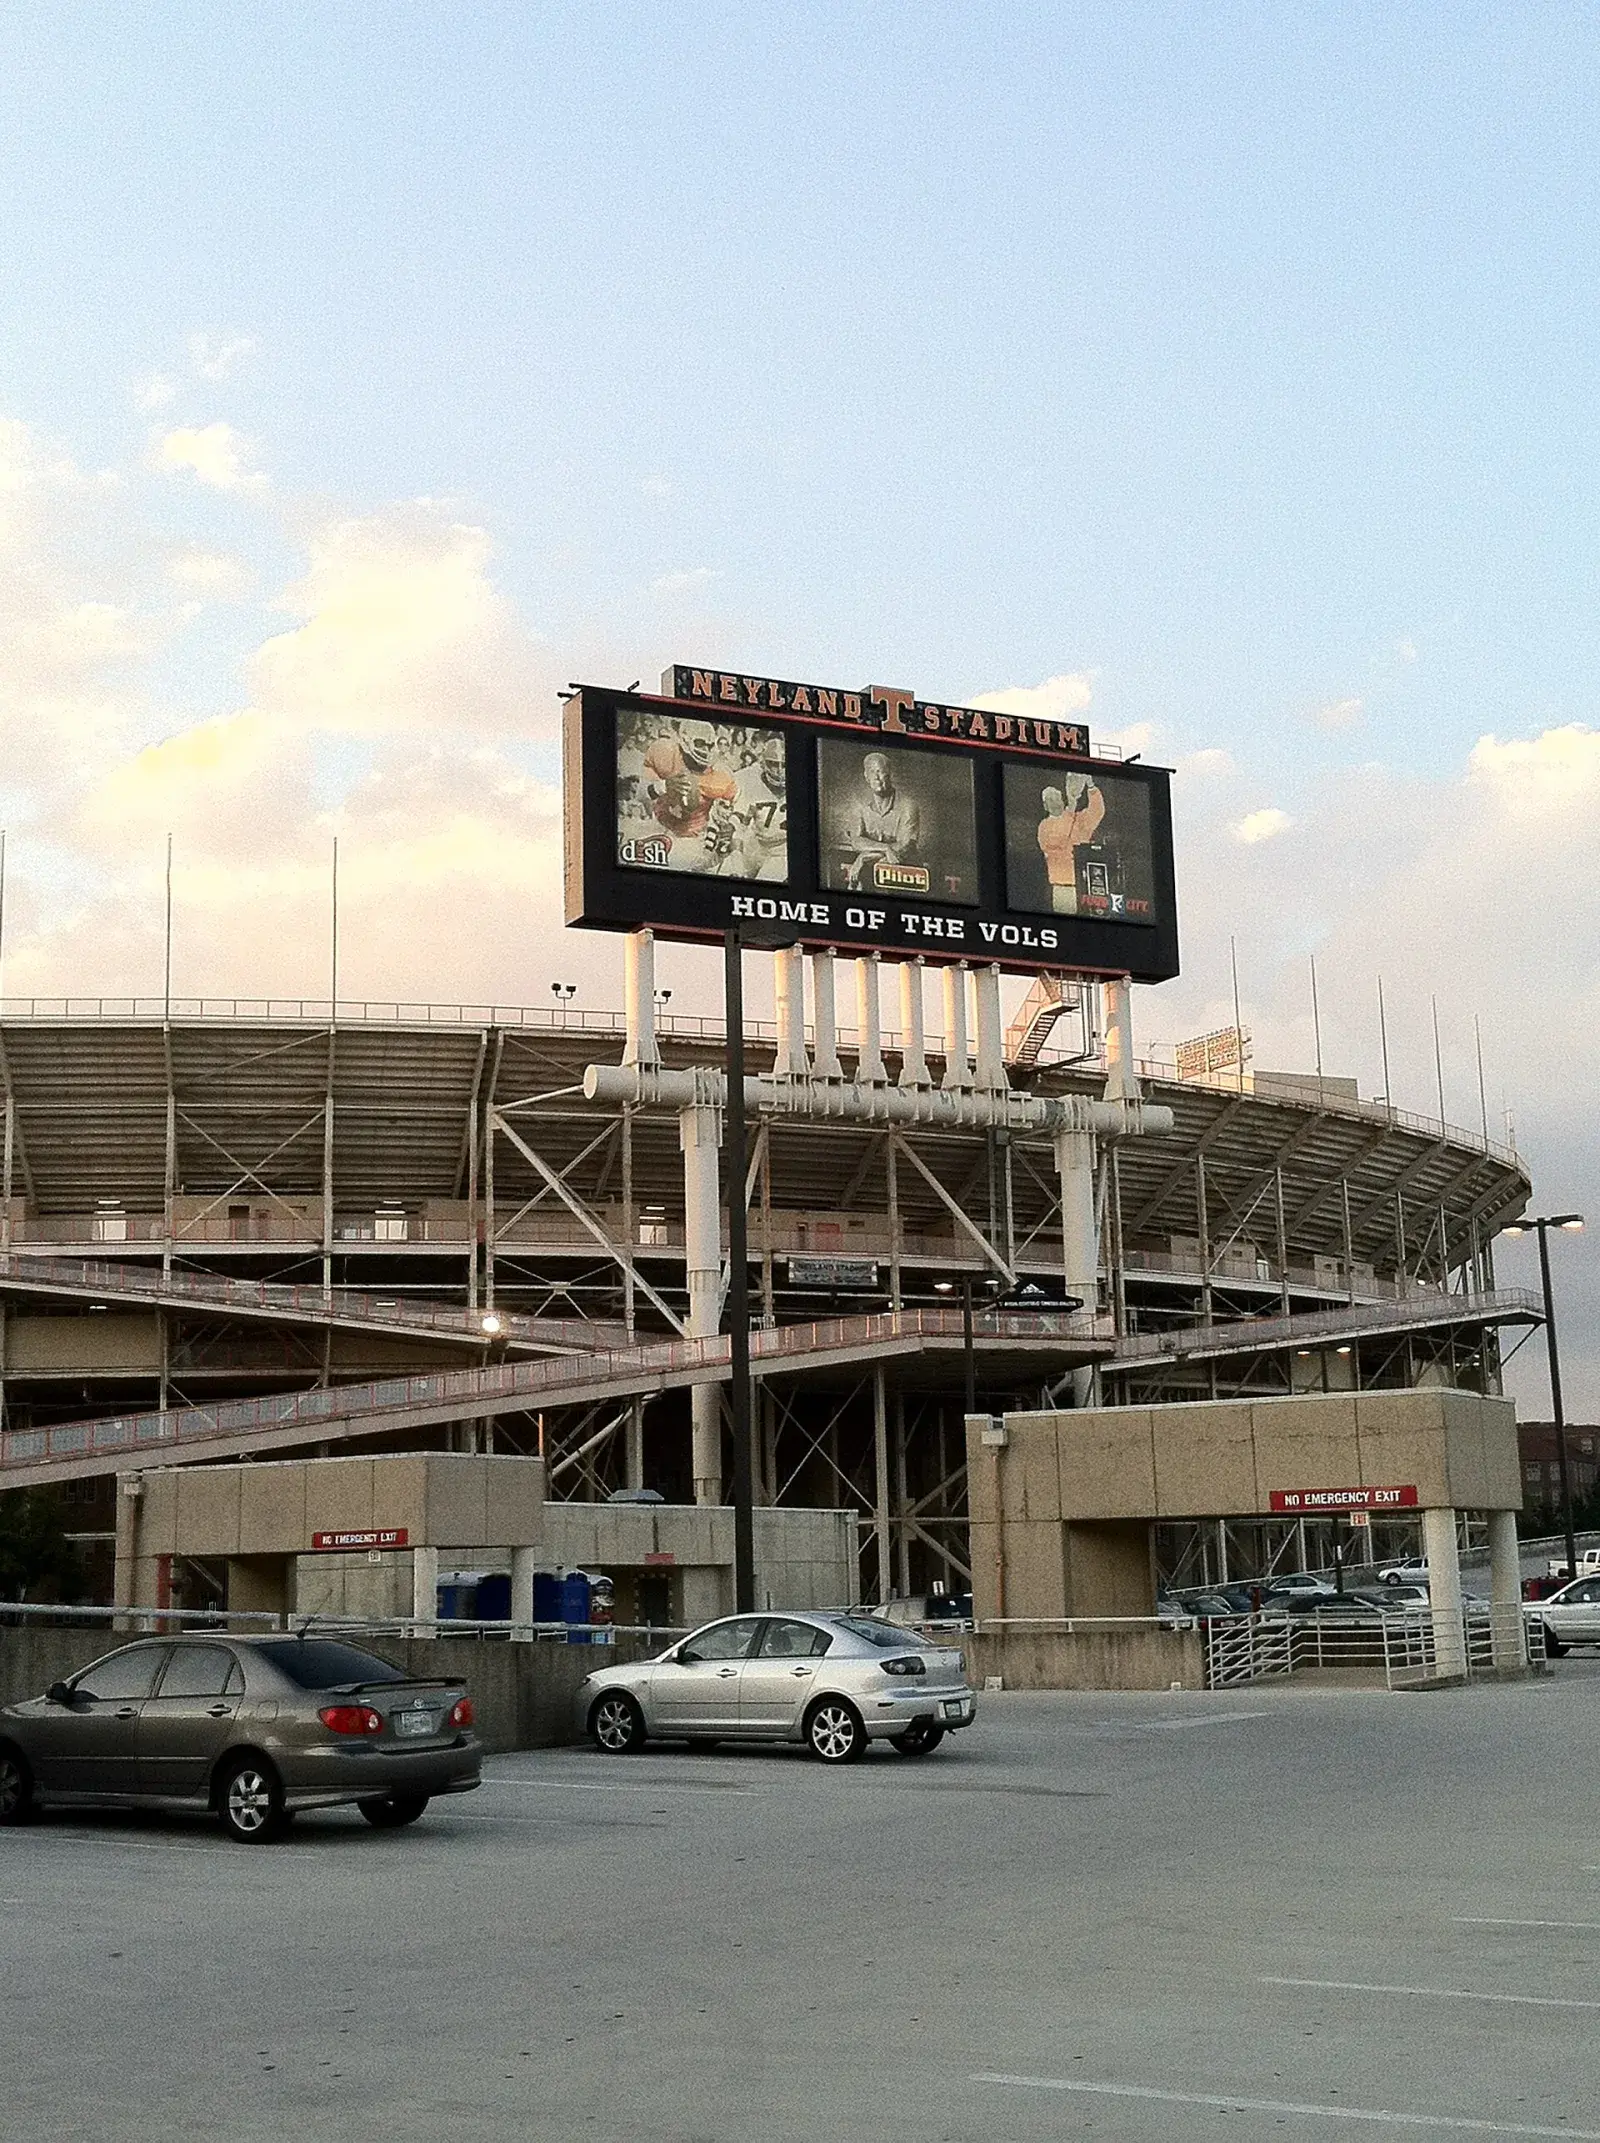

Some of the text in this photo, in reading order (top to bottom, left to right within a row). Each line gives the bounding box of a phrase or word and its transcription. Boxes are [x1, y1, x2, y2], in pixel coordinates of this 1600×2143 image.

[691, 670, 1080, 750] NEYLAND T STADIUM
[621, 840, 668, 866] dish
[731, 895, 1058, 949] HOME OF THE VOLS
[1284, 1490, 1401, 1506] NO EMERGENCY EXIT
[322, 1535, 332, 1545] NO
[335, 1533, 377, 1544] EMERGENCY
